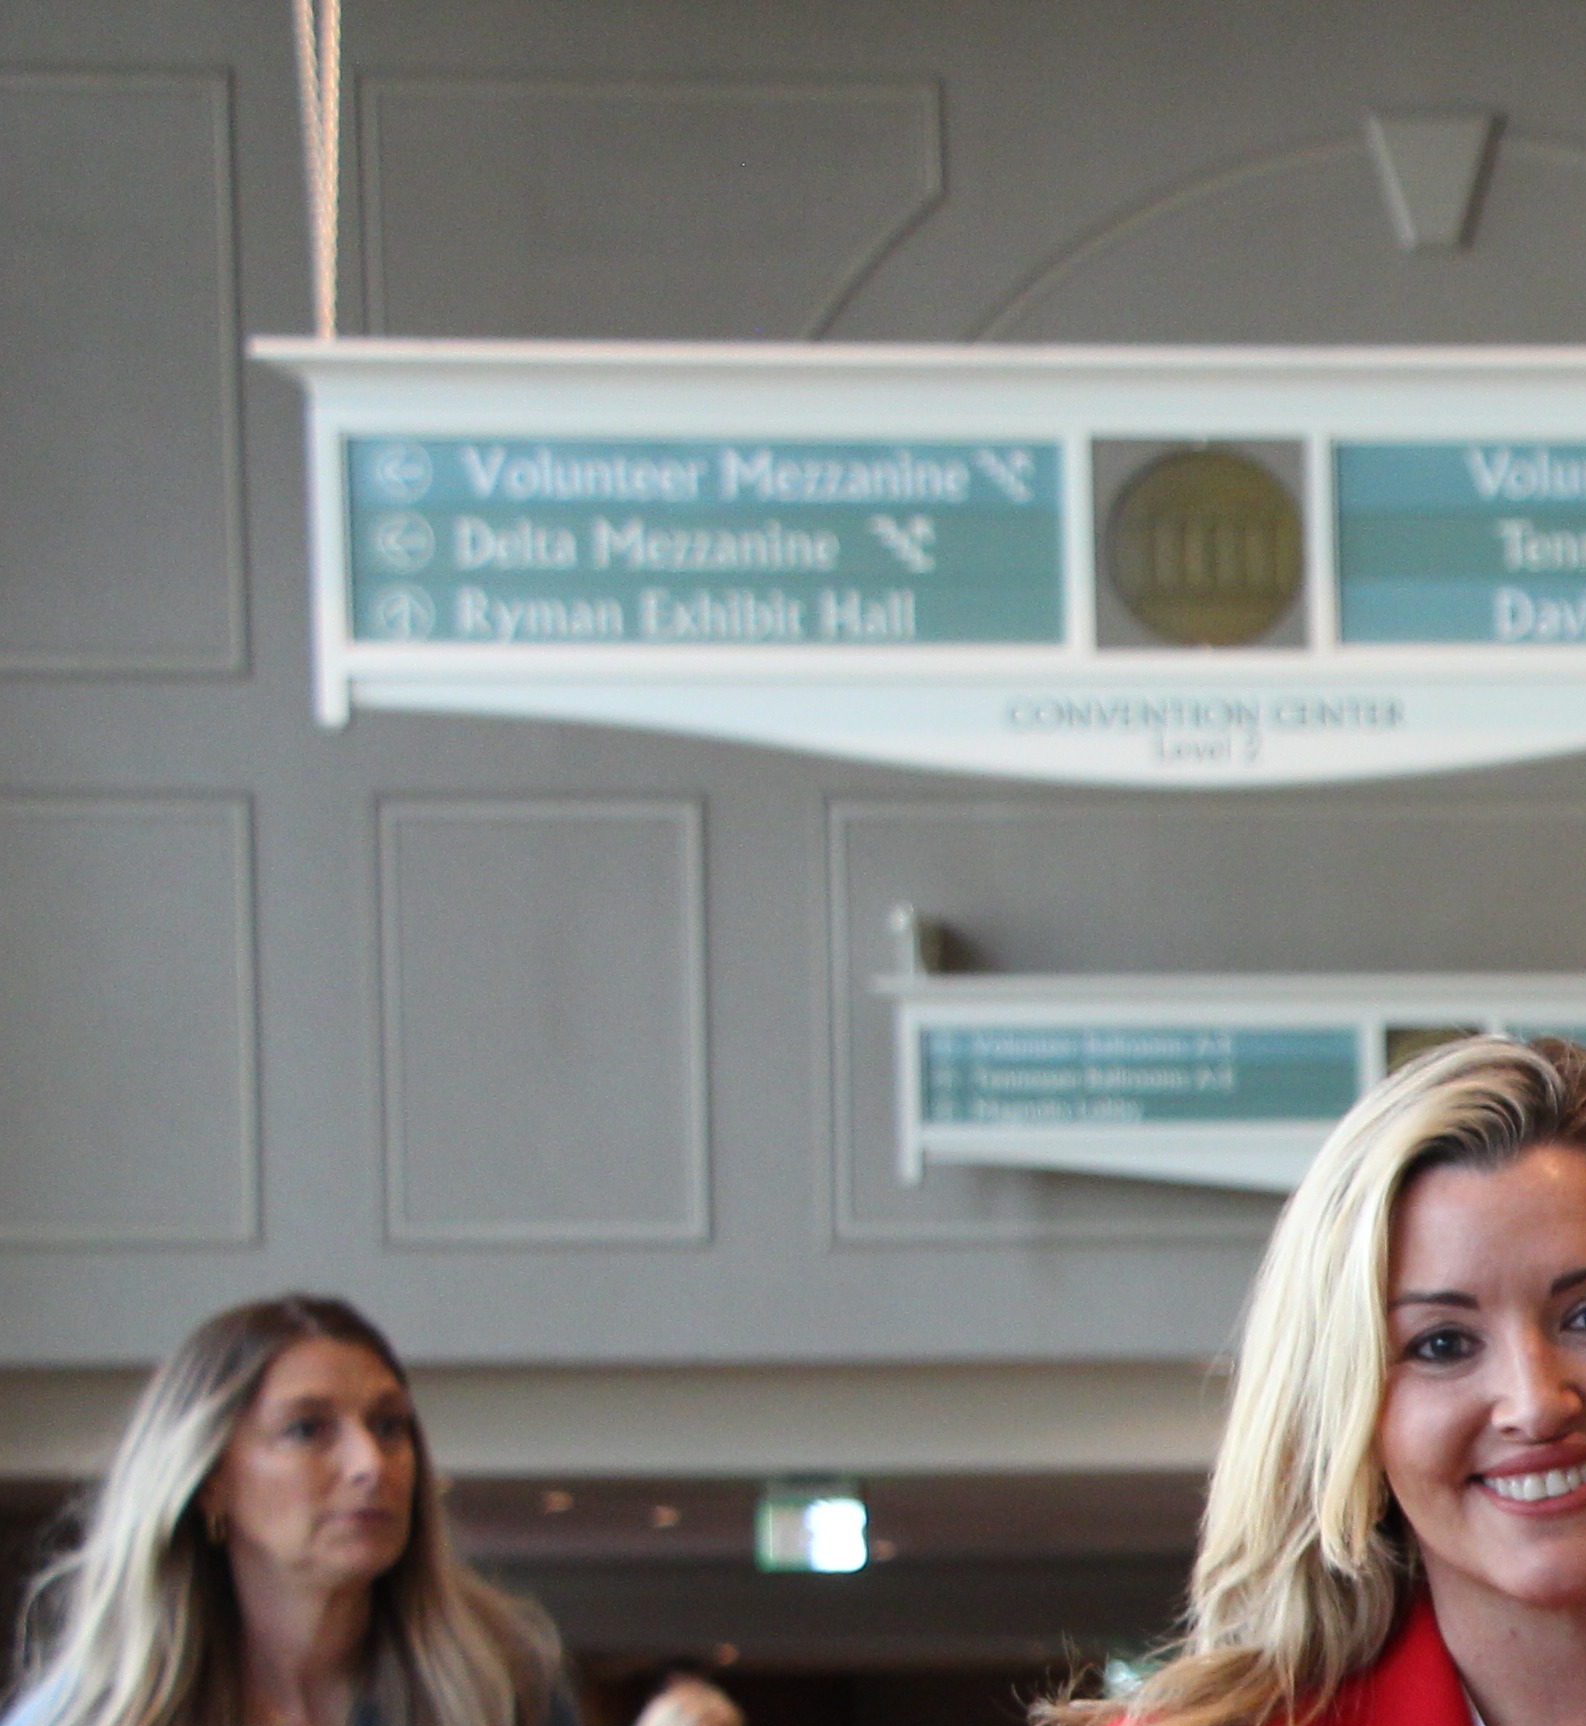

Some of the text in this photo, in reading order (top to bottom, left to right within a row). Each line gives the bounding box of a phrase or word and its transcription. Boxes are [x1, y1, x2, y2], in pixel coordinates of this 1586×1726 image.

[461, 447, 970, 500] Volunteer Mezzanine
[453, 516, 839, 570] Delta Mezzanine
[454, 587, 916, 645] Ryman Exhibit Hall
[1007, 696, 1406, 728] CONVENTION CENTER
